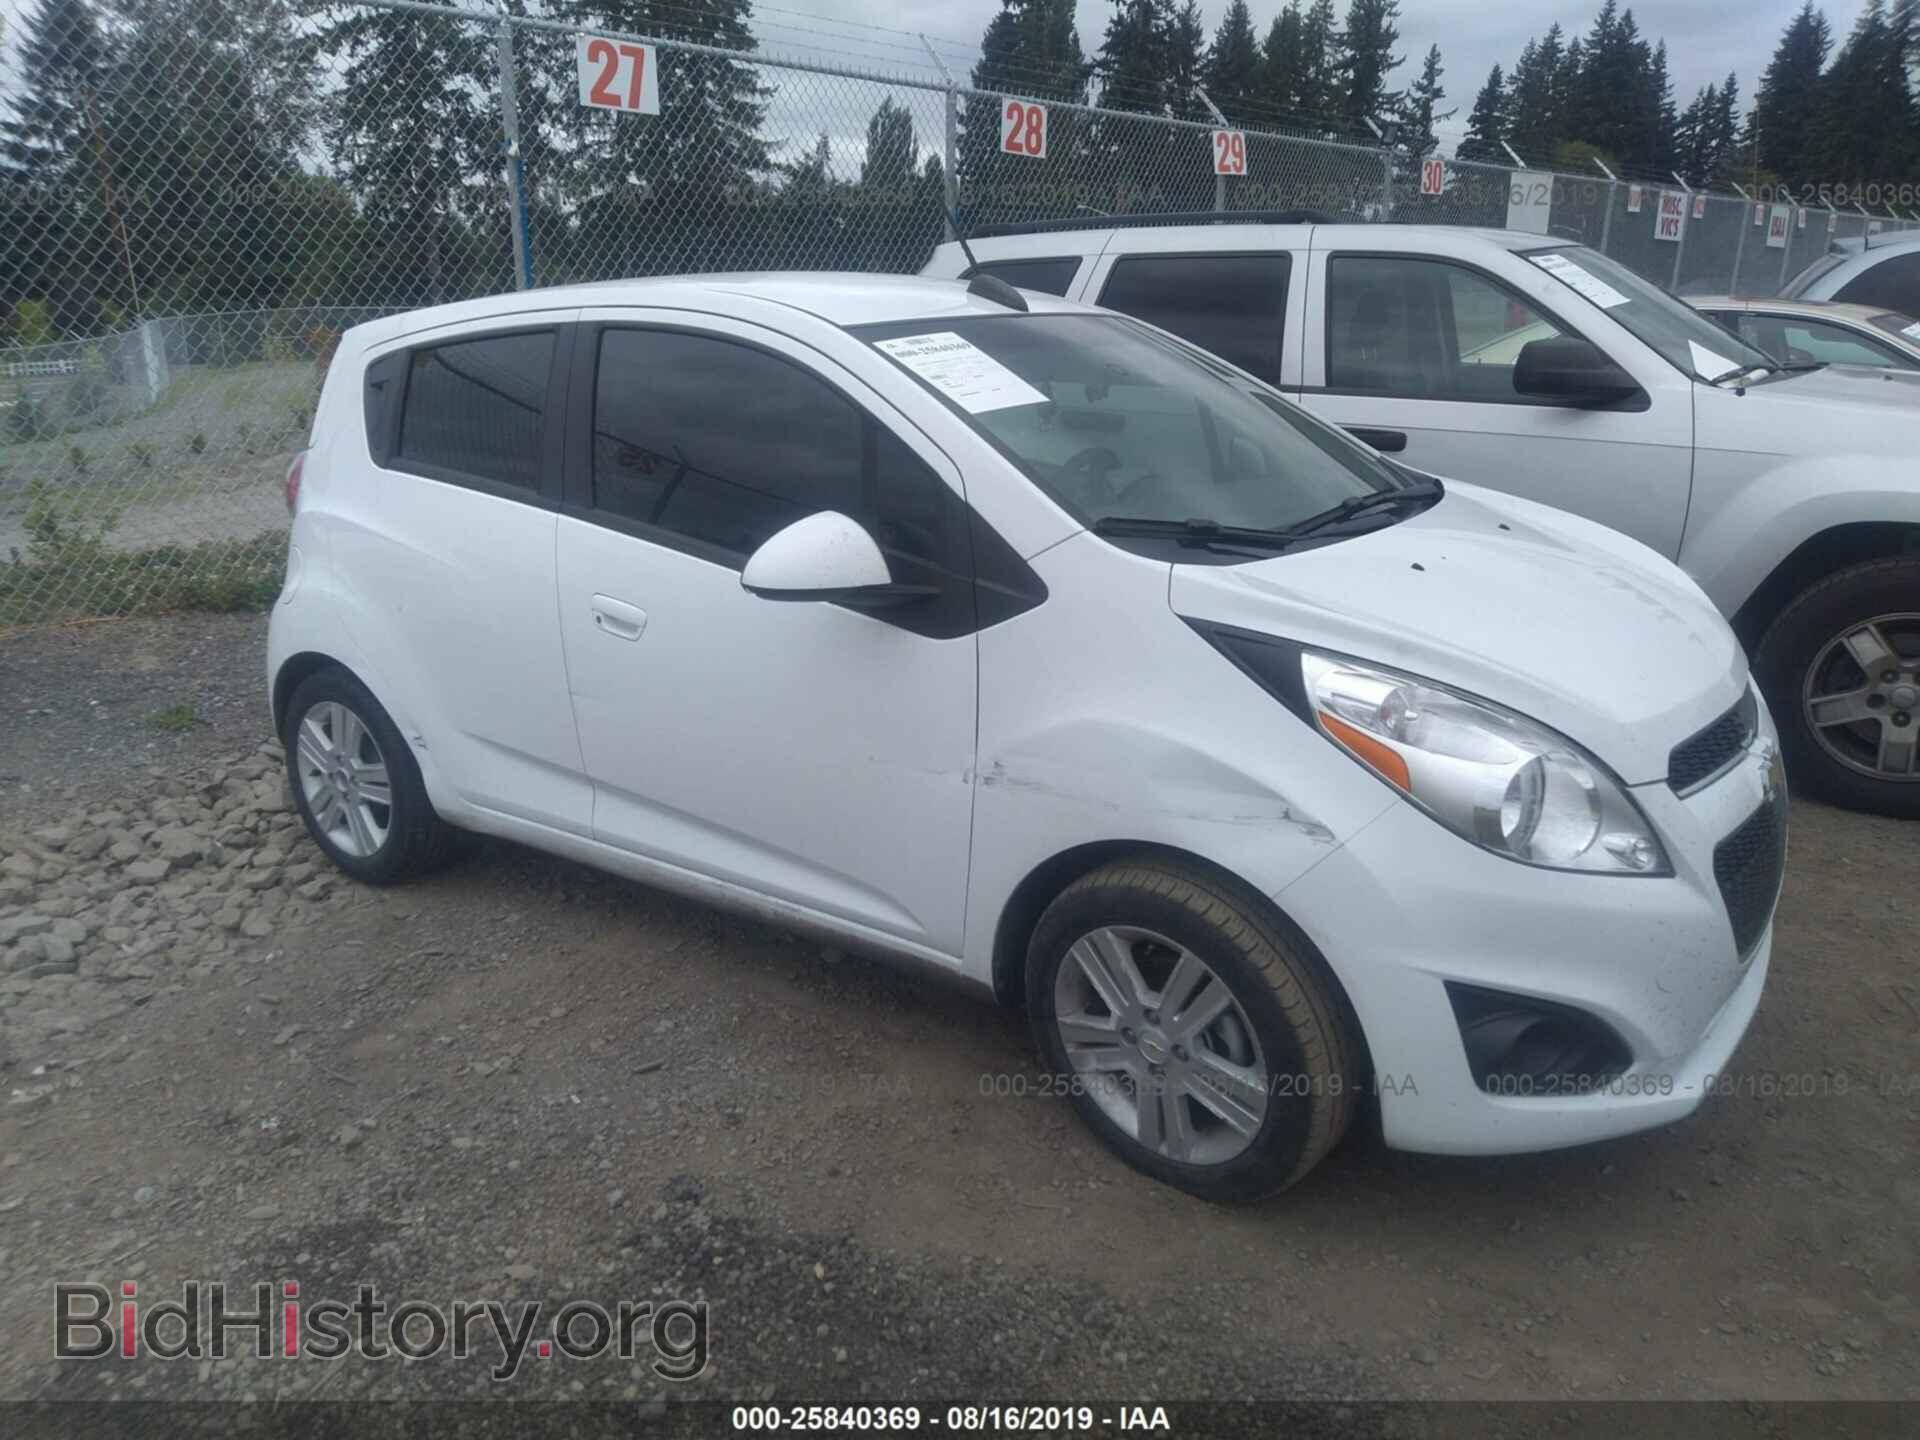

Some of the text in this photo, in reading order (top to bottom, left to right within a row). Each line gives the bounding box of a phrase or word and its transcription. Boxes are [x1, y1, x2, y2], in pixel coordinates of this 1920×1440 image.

[587, 39, 645, 109] 27
[1006, 102, 1042, 155] 28
[1216, 132, 1244, 173] 29
[1423, 161, 1442, 193] 30
